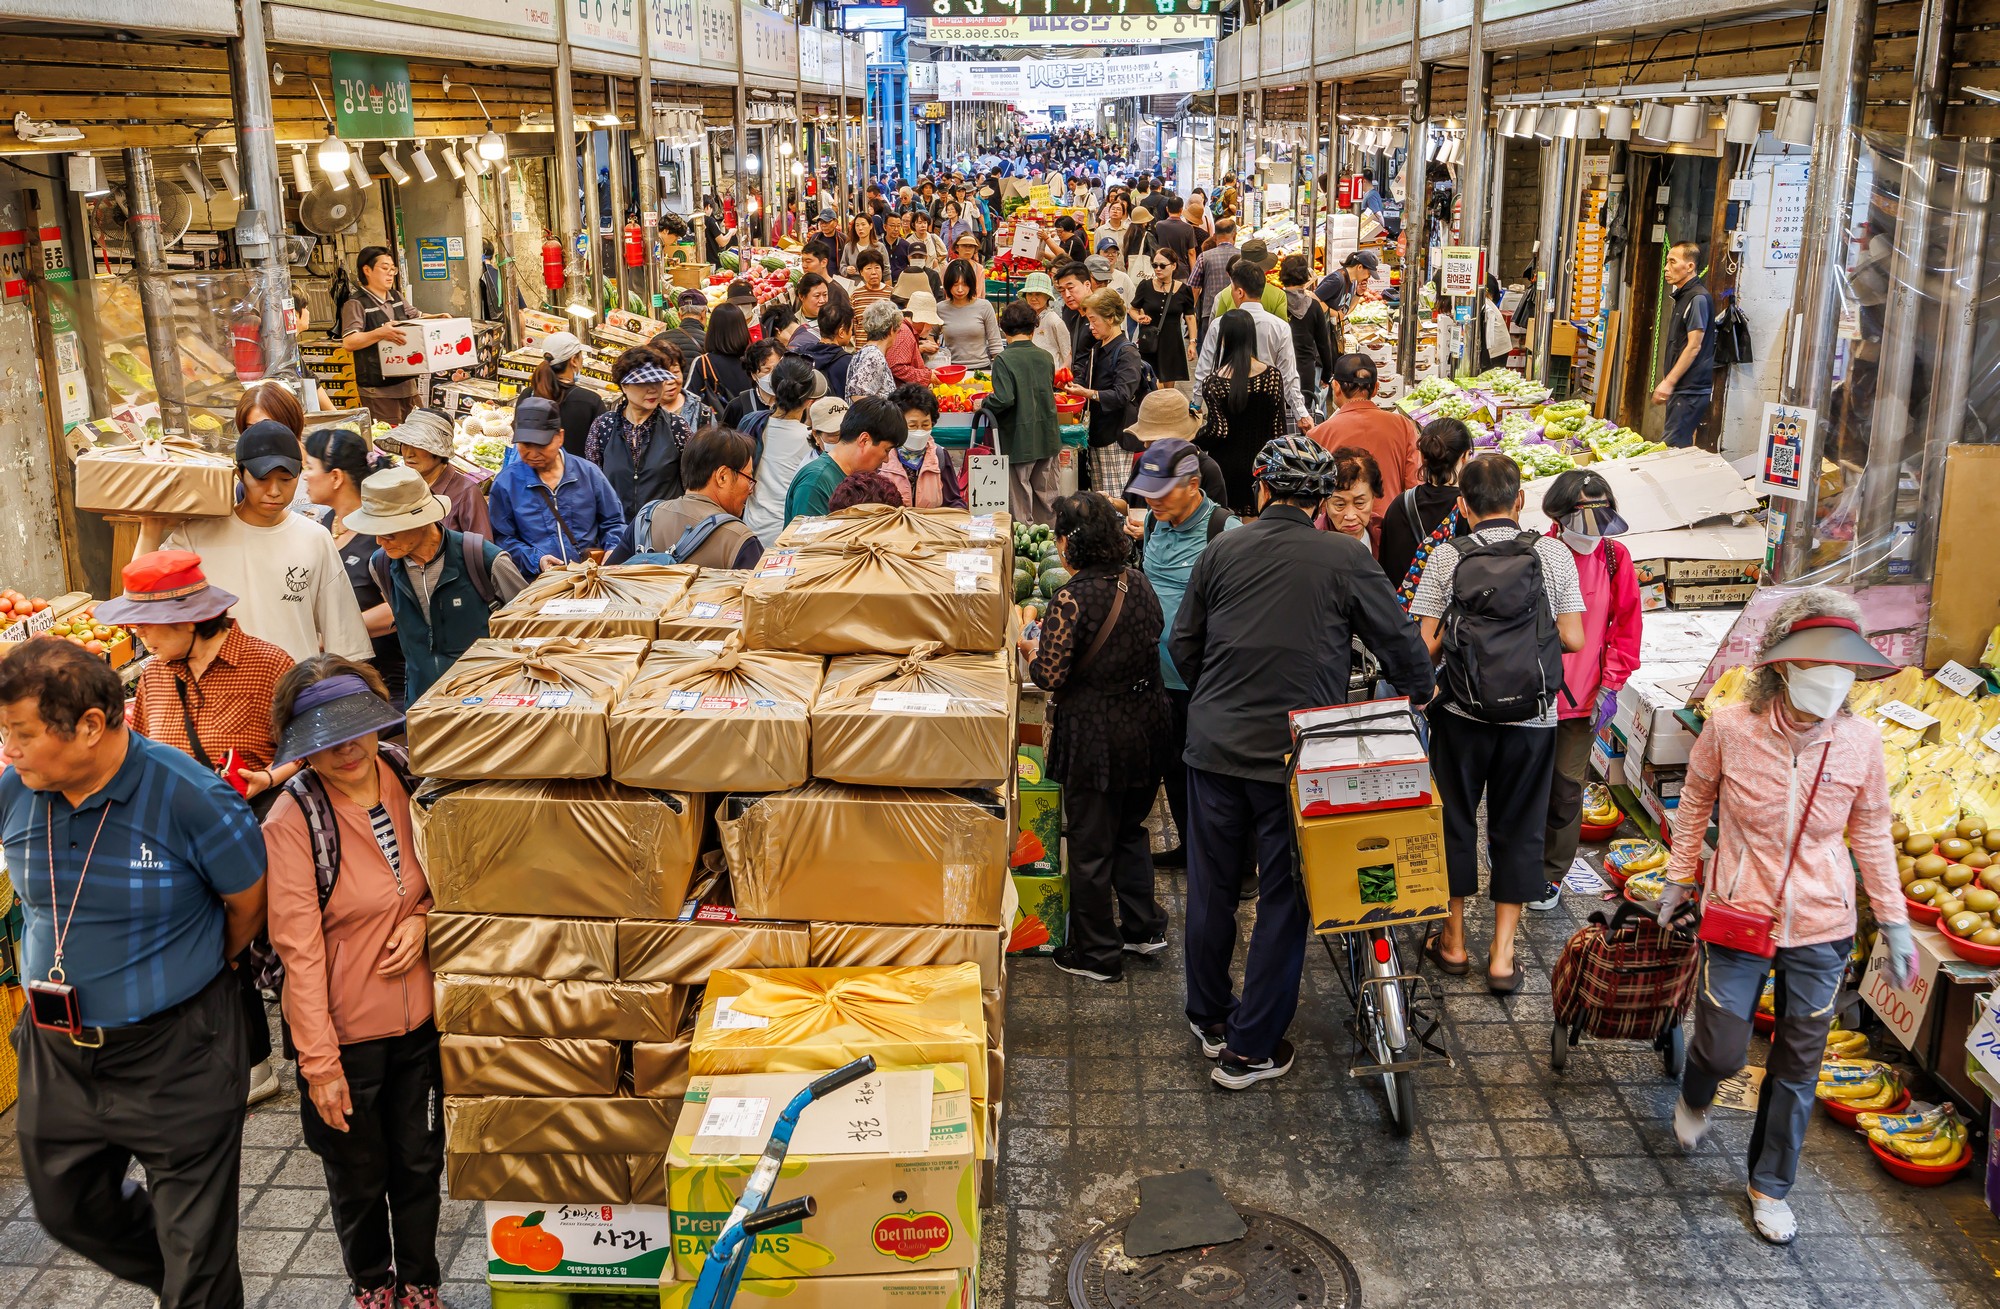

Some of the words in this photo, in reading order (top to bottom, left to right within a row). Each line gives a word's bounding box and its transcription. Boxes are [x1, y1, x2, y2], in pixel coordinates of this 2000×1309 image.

[340, 79, 369, 114] 강오
[385, 80, 409, 115] 상회
[3, 251, 26, 275] CCT
[1446, 262, 1472, 274] 환급행사
[1446, 273, 1471, 284] 참여점포
[433, 343, 453, 356] 사과
[385, 355, 405, 364] 사과
[281, 593, 305, 603] BARON
[130, 860, 164, 868] HAZZYS
[1035, 861, 1050, 870] 20kg
[878, 1228, 900, 1242] Del
[903, 1226, 946, 1241] Monte
[593, 1229, 653, 1252] 사과
[898, 1241, 927, 1252] Quality
